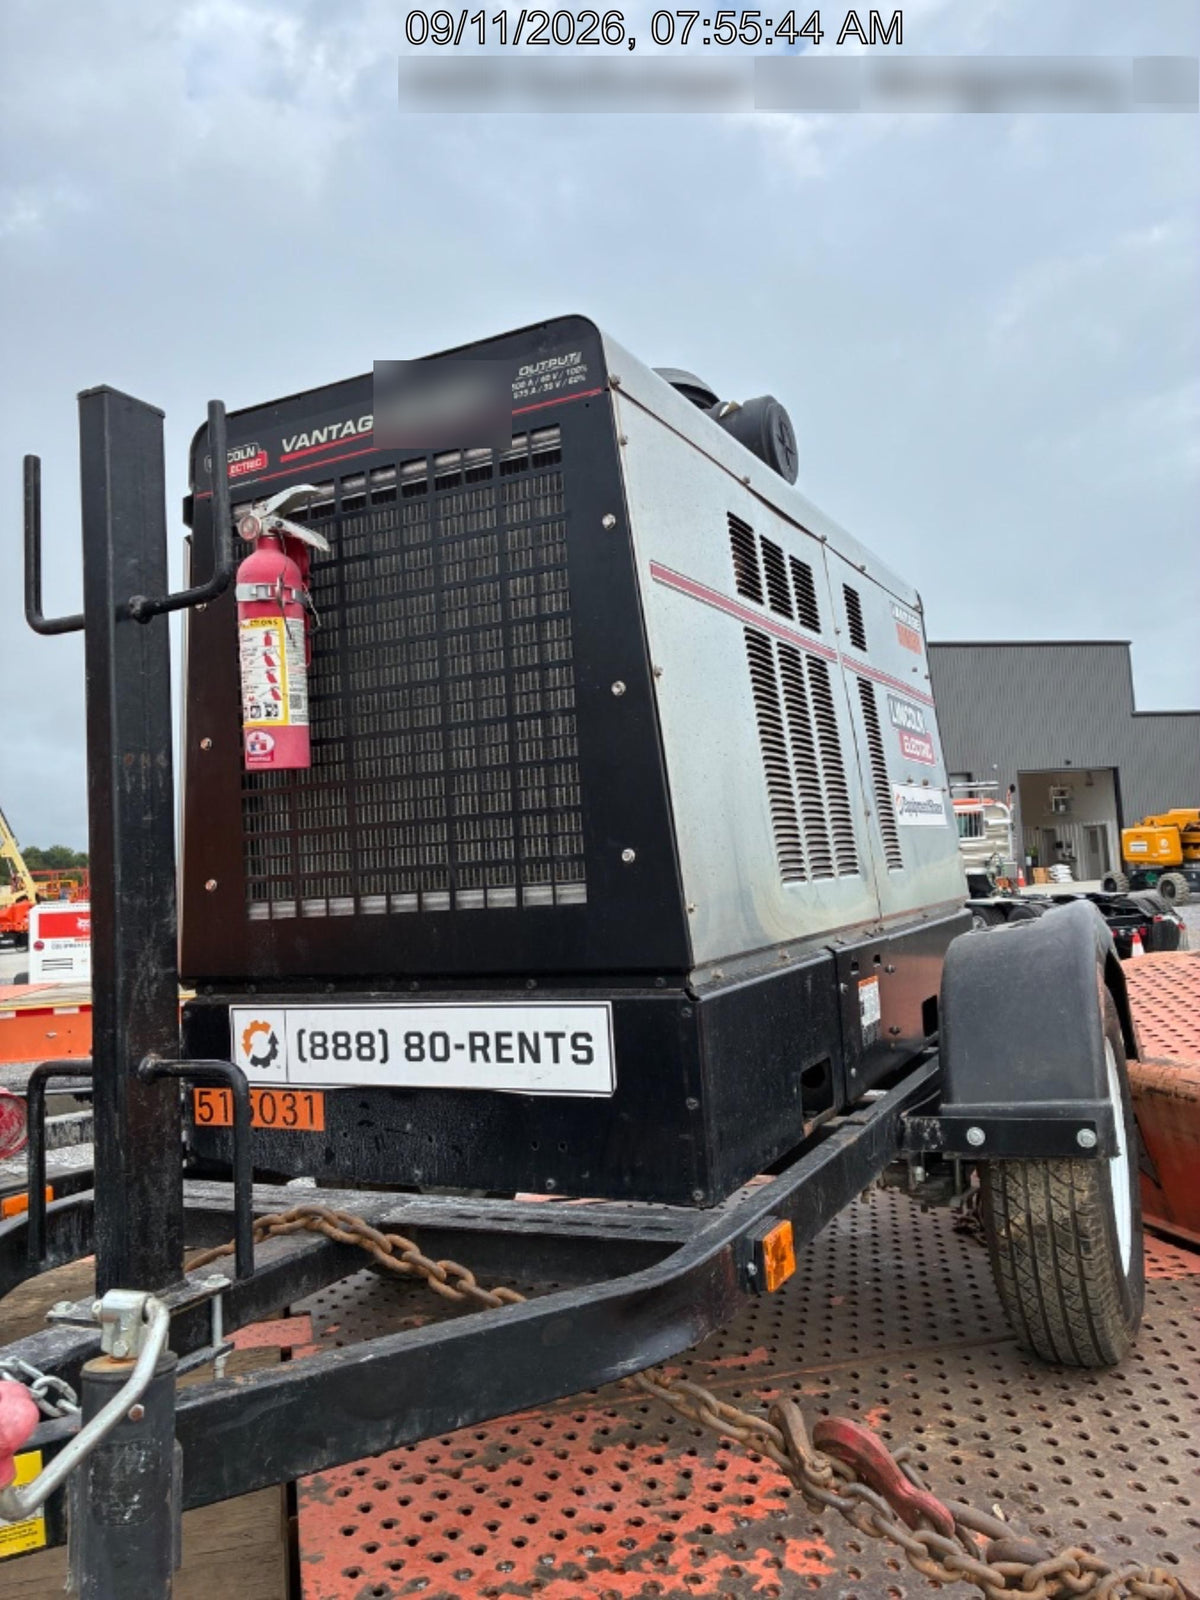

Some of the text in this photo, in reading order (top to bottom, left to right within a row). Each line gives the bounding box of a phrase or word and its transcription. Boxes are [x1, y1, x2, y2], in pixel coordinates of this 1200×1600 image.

[518, 352, 578, 376] OUTPUT
[281, 413, 373, 453] VANTAG
[296, 1028, 594, 1065] (888) 80-RENTS
